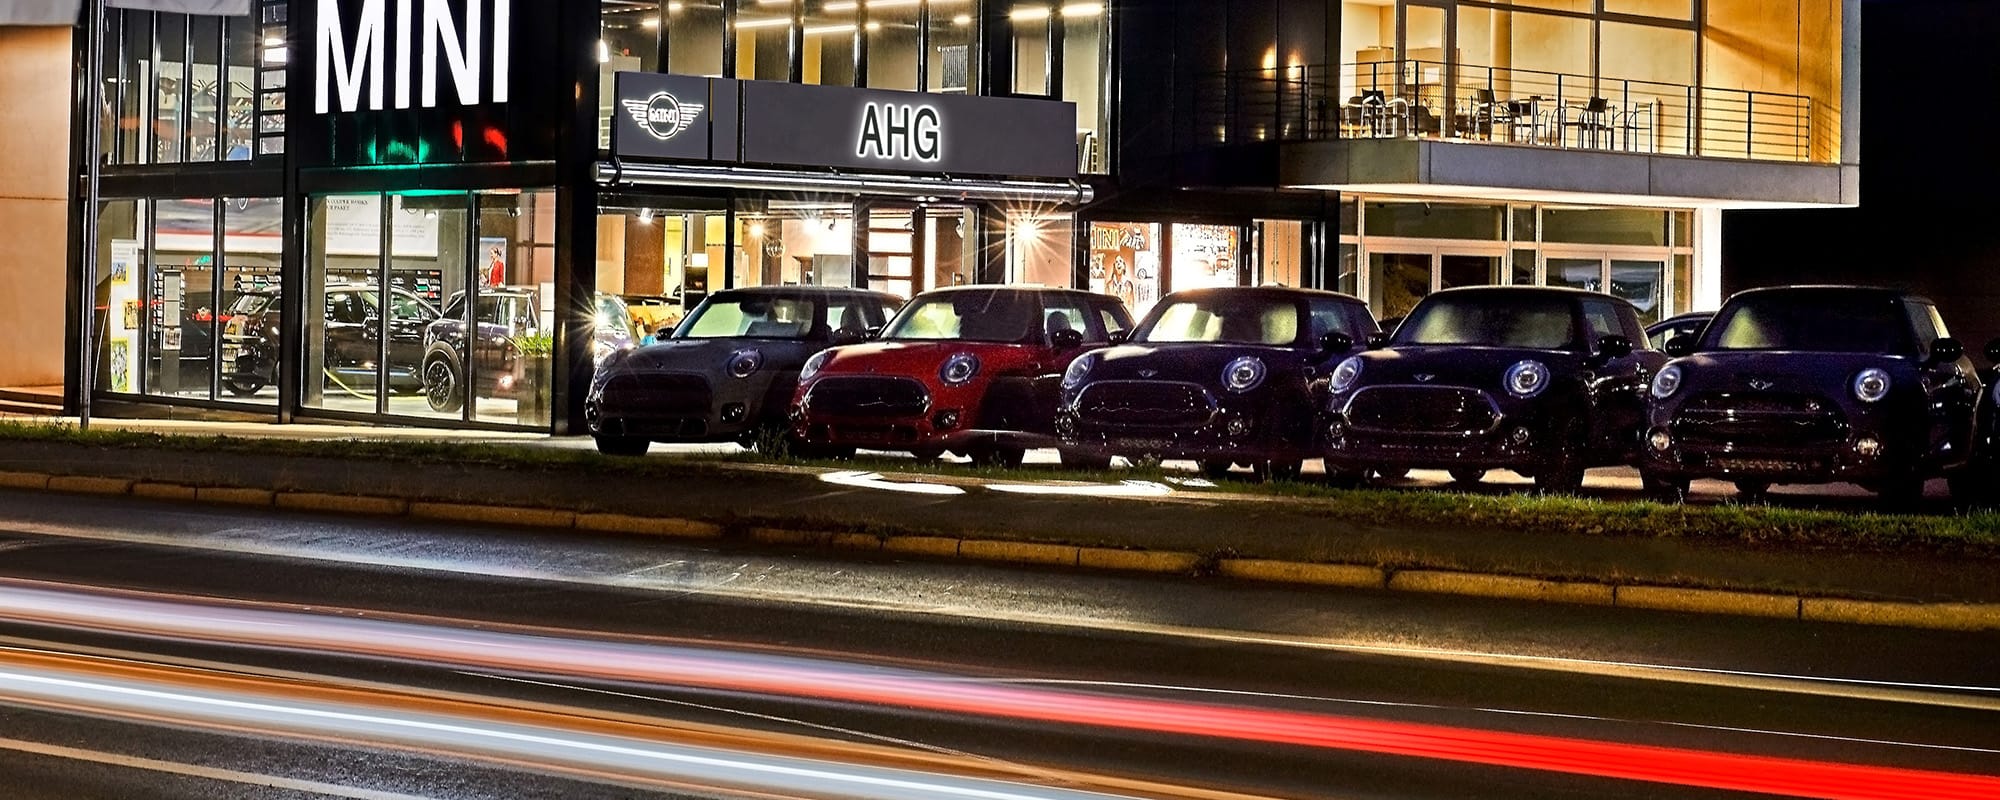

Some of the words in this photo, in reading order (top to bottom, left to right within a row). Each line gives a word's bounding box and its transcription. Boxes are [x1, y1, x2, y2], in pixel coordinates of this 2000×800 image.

[314, 0, 510, 115] MINI
[649, 107, 677, 123] MINI
[858, 103, 939, 161] AHG
